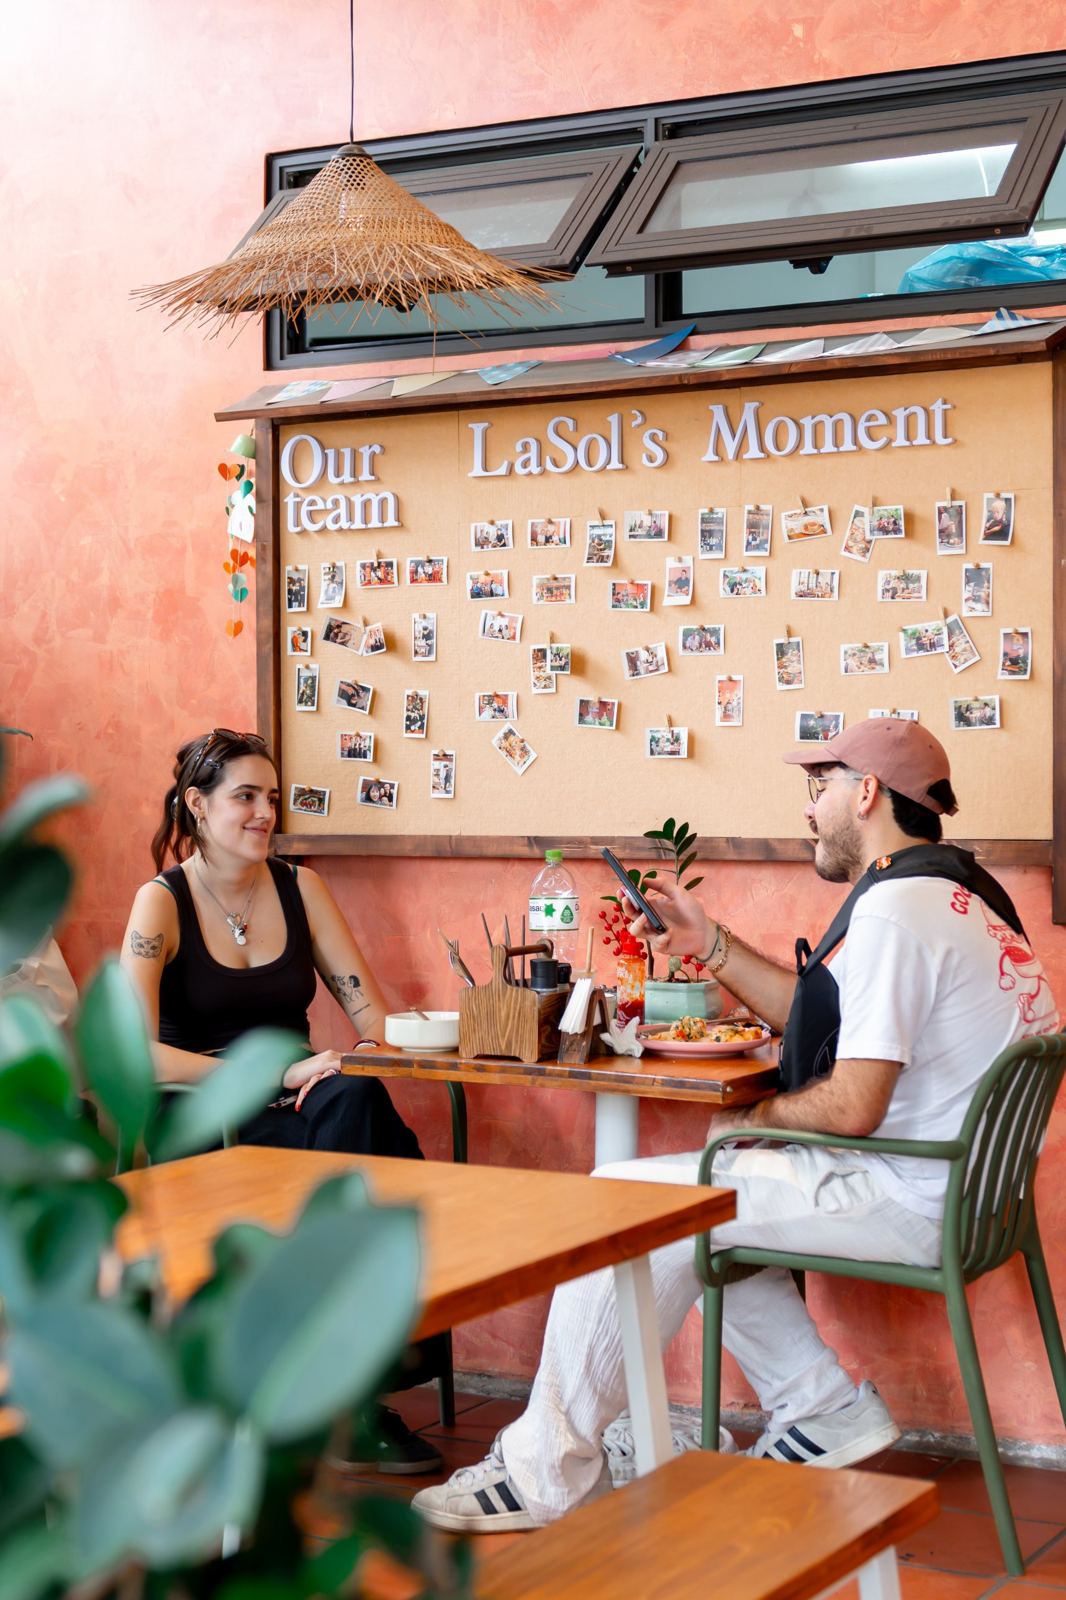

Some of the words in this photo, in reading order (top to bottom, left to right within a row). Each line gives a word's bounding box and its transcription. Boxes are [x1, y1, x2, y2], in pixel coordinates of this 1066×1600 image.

[280, 434, 384, 488] Our
[467, 409, 668, 478] LaSol's
[701, 397, 956, 463] Moment
[284, 491, 401, 533] team
